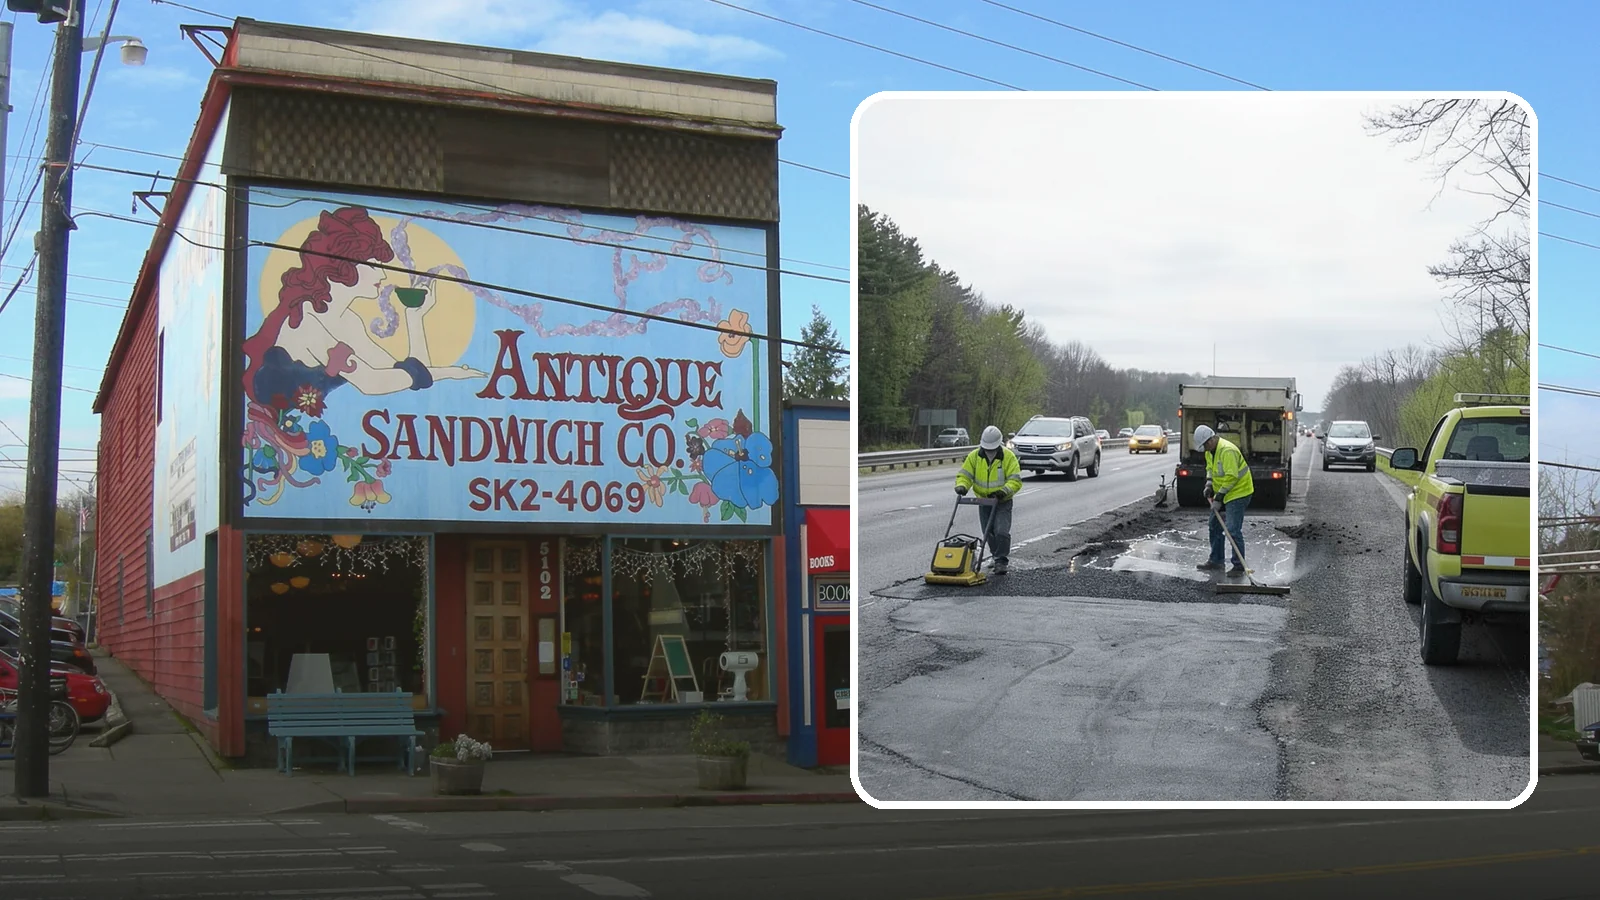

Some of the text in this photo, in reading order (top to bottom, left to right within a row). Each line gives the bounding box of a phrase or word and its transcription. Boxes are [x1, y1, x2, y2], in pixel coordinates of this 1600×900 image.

[476, 329, 724, 419] ANTIQUE
[361, 408, 686, 469] SANDWICH CO.
[468, 477, 645, 514] SK2-4069
[540, 542, 551, 599] 5102
[809, 555, 834, 568] BOOKS
